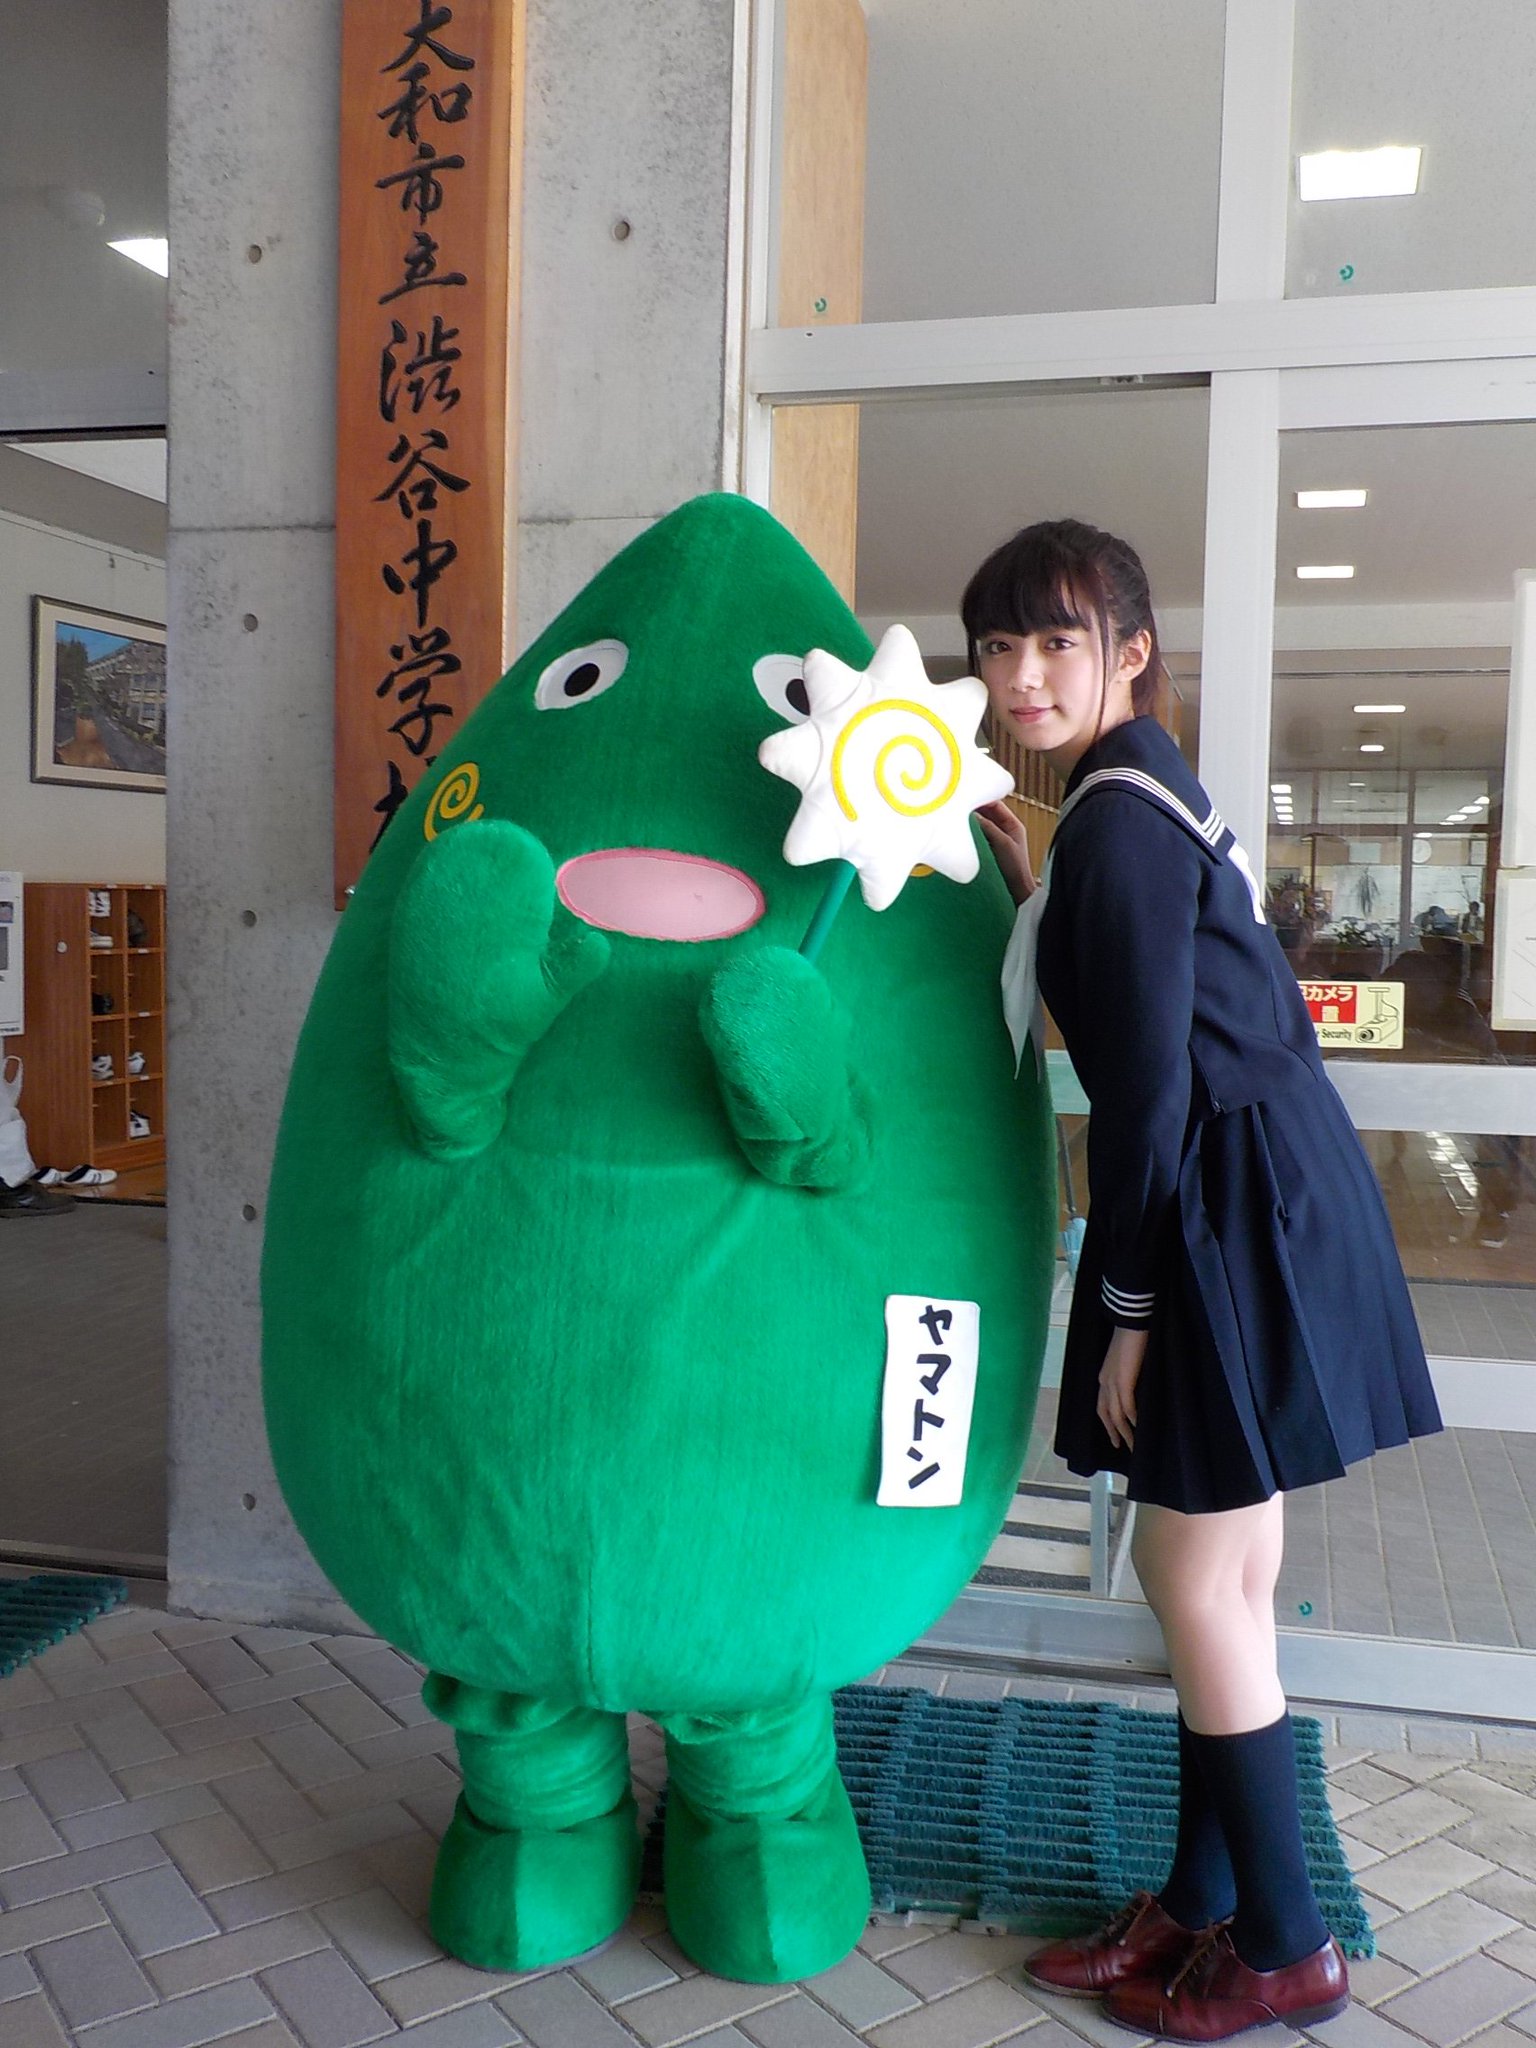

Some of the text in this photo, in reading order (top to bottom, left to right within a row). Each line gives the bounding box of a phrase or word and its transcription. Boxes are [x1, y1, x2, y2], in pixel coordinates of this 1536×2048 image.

[1321, 1028, 1352, 1041] Security
[907, 1305, 952, 1489] ヤマトン
